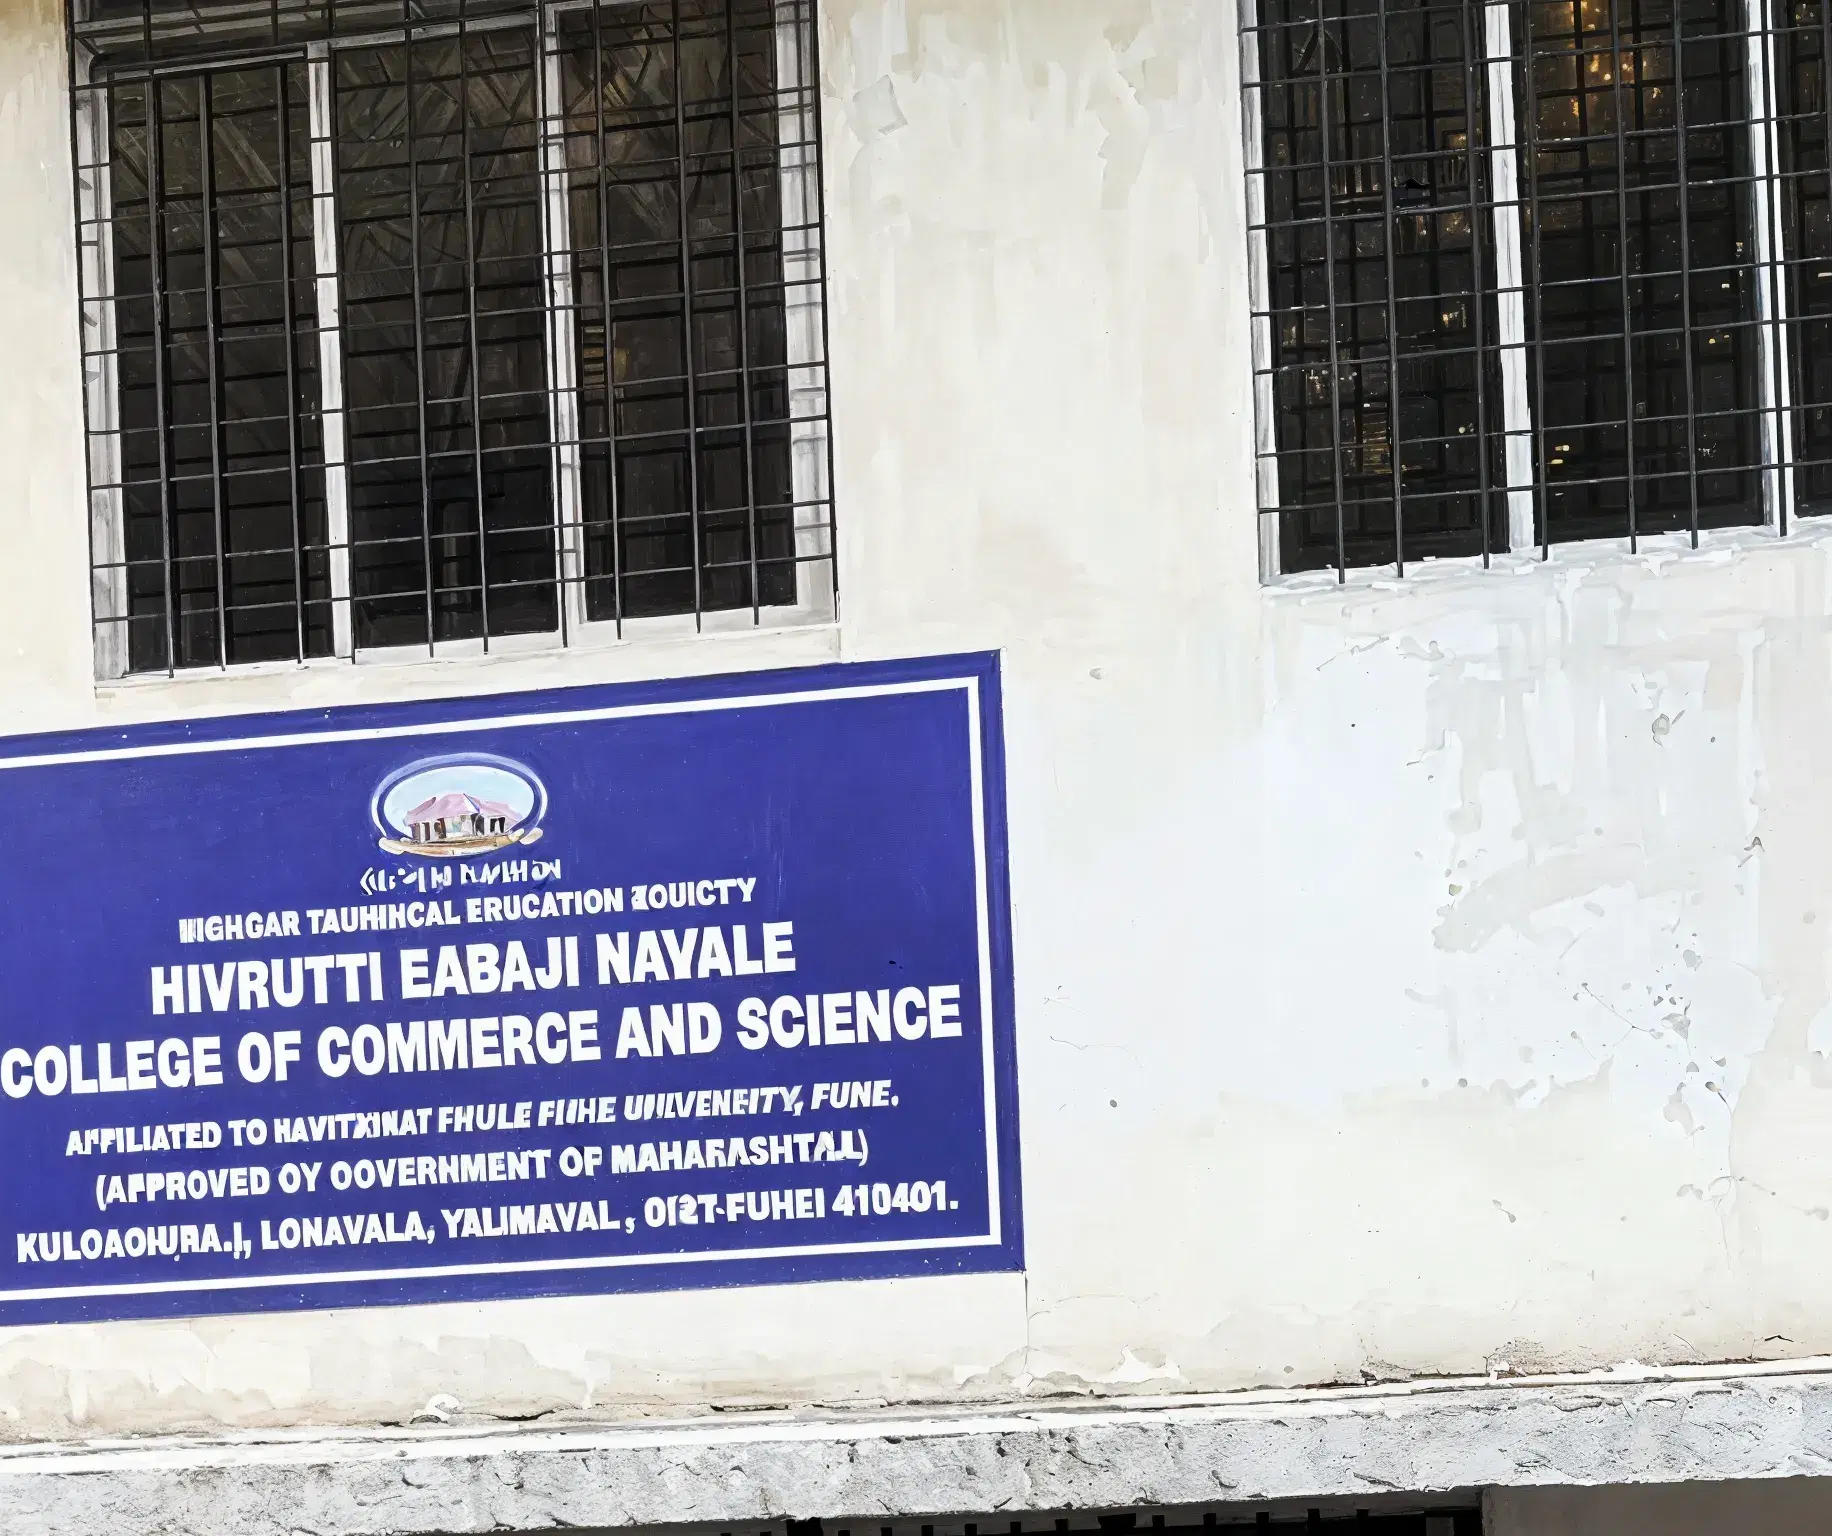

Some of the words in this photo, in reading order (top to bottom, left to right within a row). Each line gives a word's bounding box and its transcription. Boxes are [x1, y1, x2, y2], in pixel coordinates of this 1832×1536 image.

[466, 888, 623, 923] ERUCATION
[151, 952, 383, 1014] HIVRUTTI
[400, 936, 579, 999] EABAJI
[1, 1036, 223, 1098] COLLEGE
[238, 1031, 301, 1083] OF
[318, 1010, 601, 1077] COMMERCE
[615, 1002, 721, 1058] AND
[737, 985, 962, 1050] SCIENCE
[228, 1119, 267, 1146] TO
[261, 1211, 435, 1249] LONAVALA,
[832, 1181, 958, 1216] 410401.
